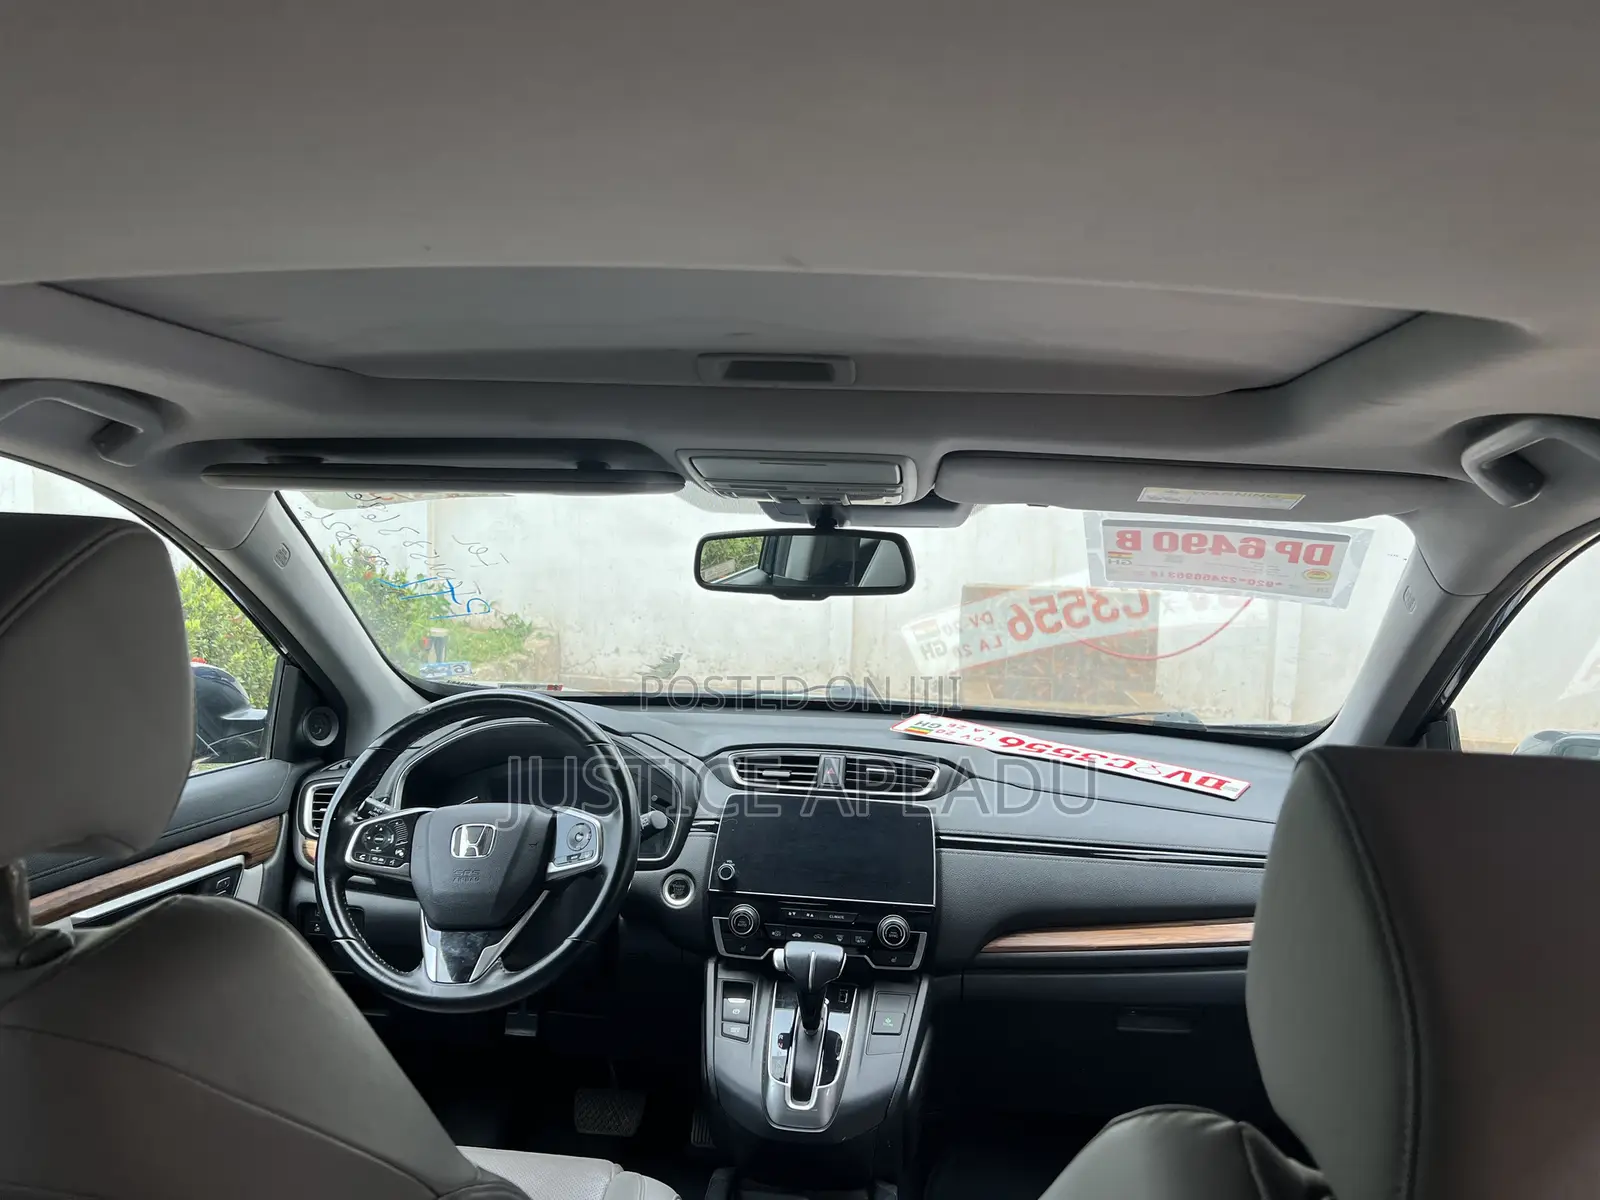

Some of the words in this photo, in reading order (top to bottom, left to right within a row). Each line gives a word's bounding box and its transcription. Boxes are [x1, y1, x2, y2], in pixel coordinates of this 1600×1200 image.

[1190, 490, 1281, 499] WARNING
[914, 720, 942, 729] GH
[997, 735, 1138, 770] C3556
[1164, 769, 1233, 792] DV
